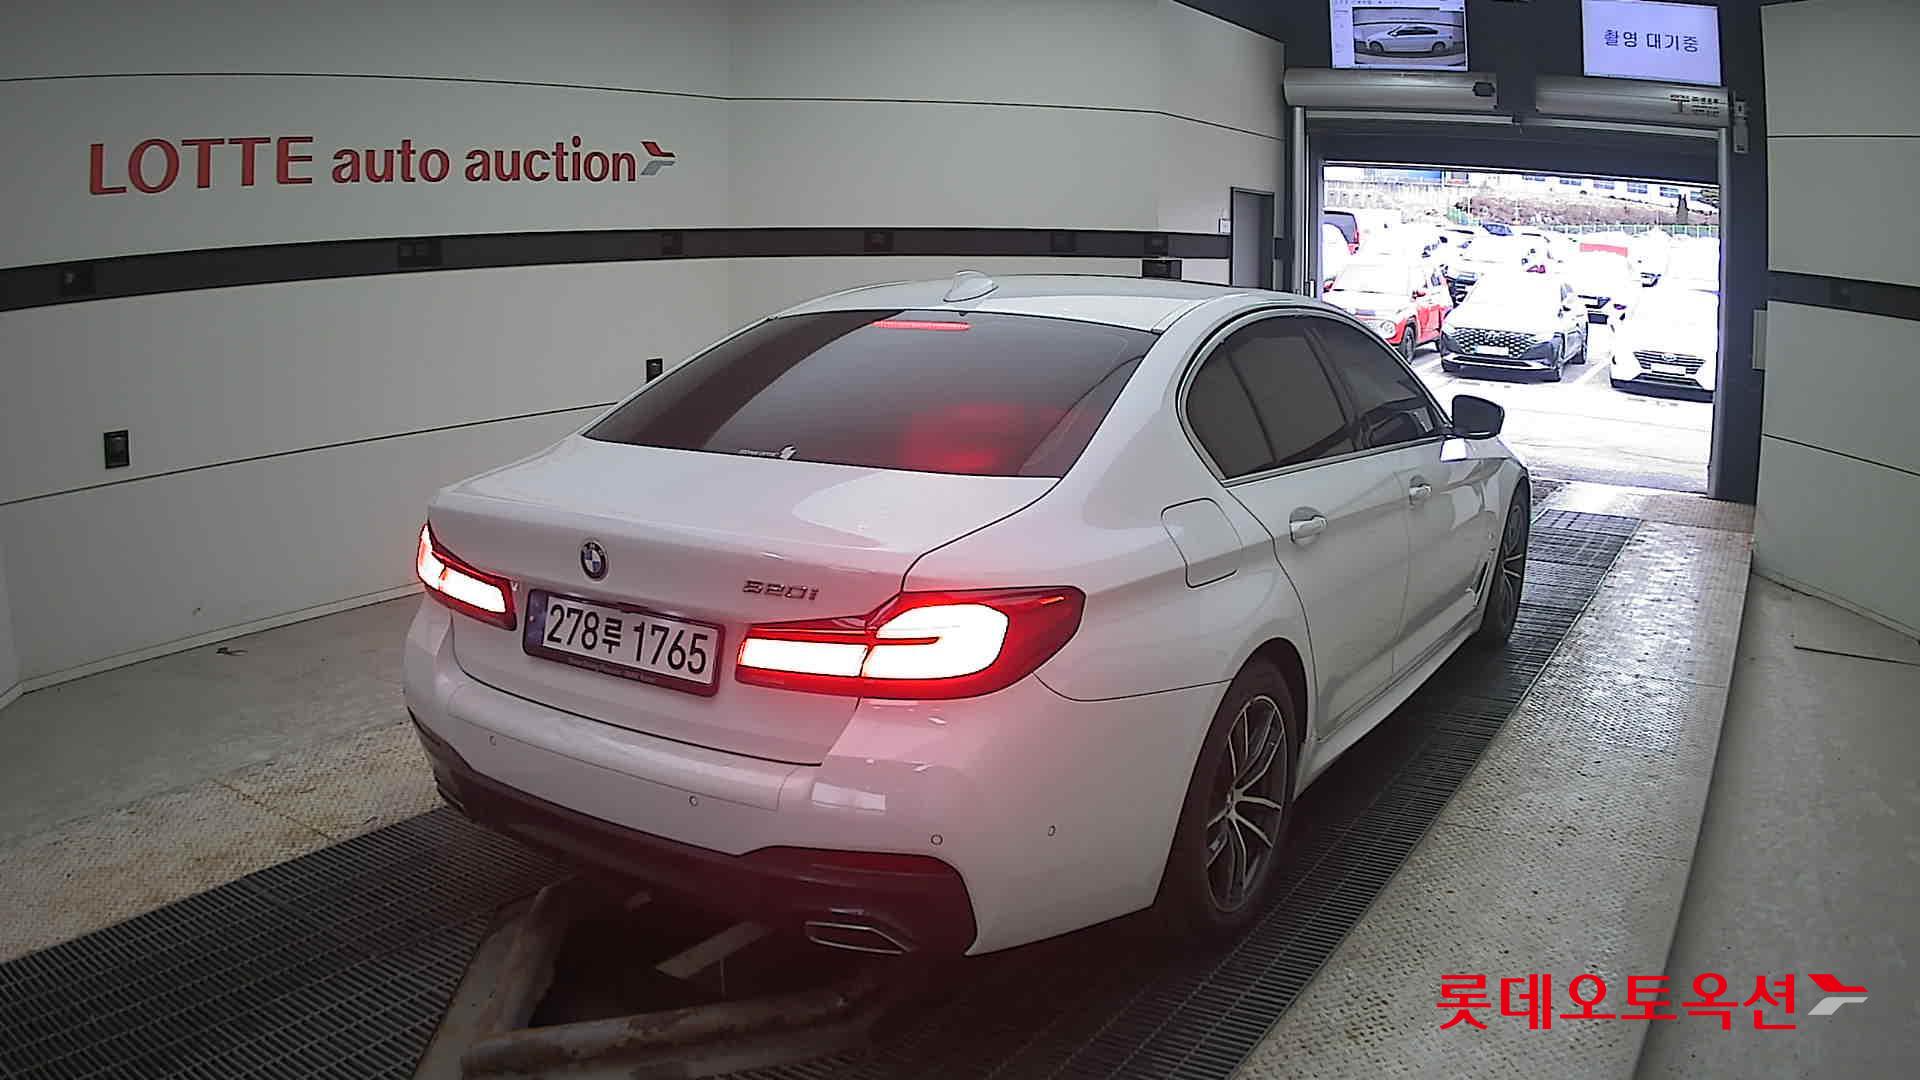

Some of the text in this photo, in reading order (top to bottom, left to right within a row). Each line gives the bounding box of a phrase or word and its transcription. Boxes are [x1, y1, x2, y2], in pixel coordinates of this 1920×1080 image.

[1603, 28, 1699, 53] 촬영 대기중
[89, 136, 637, 195] LOTTE auto auction
[549, 603, 622, 654] 278루
[633, 622, 709, 674] 1765
